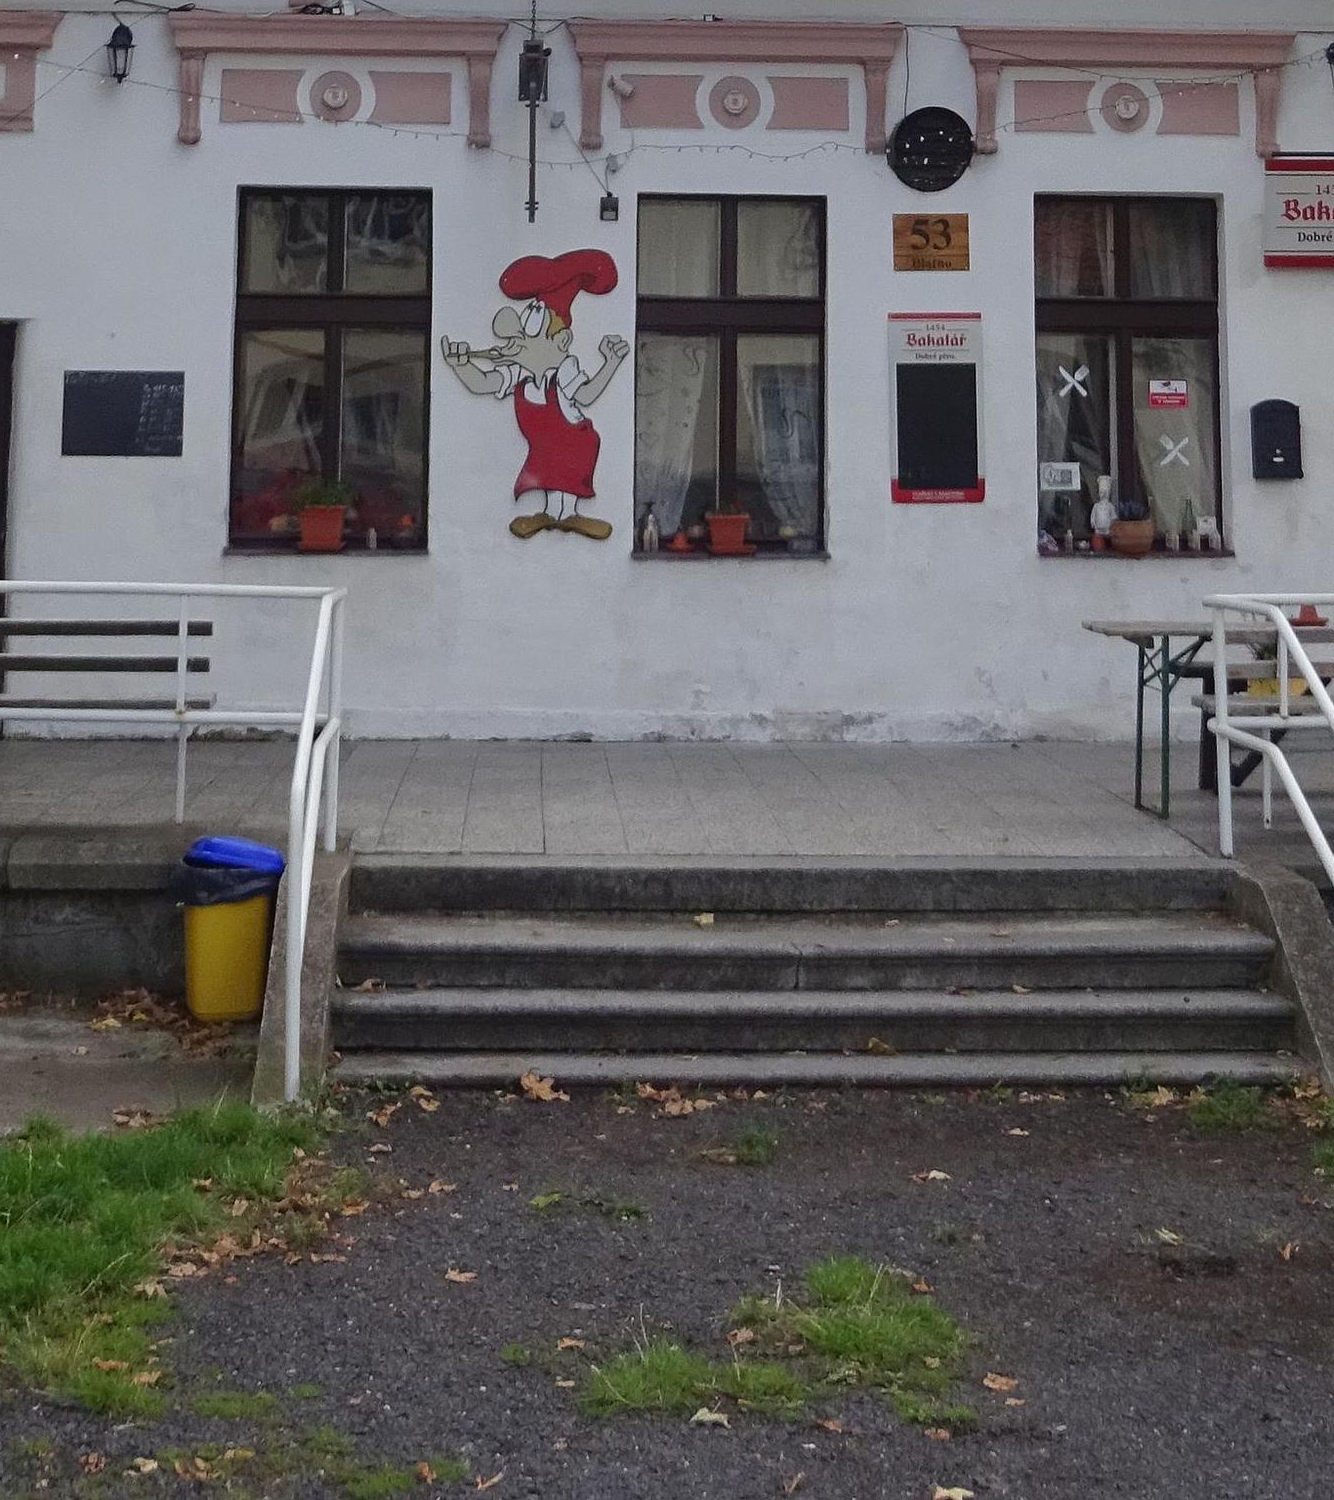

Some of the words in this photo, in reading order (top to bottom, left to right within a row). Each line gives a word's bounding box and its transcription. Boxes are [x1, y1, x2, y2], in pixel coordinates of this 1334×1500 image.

[910, 218, 952, 251] 53
[1297, 231, 1334, 243] Dobré
[906, 332, 967, 347] Bakalář
